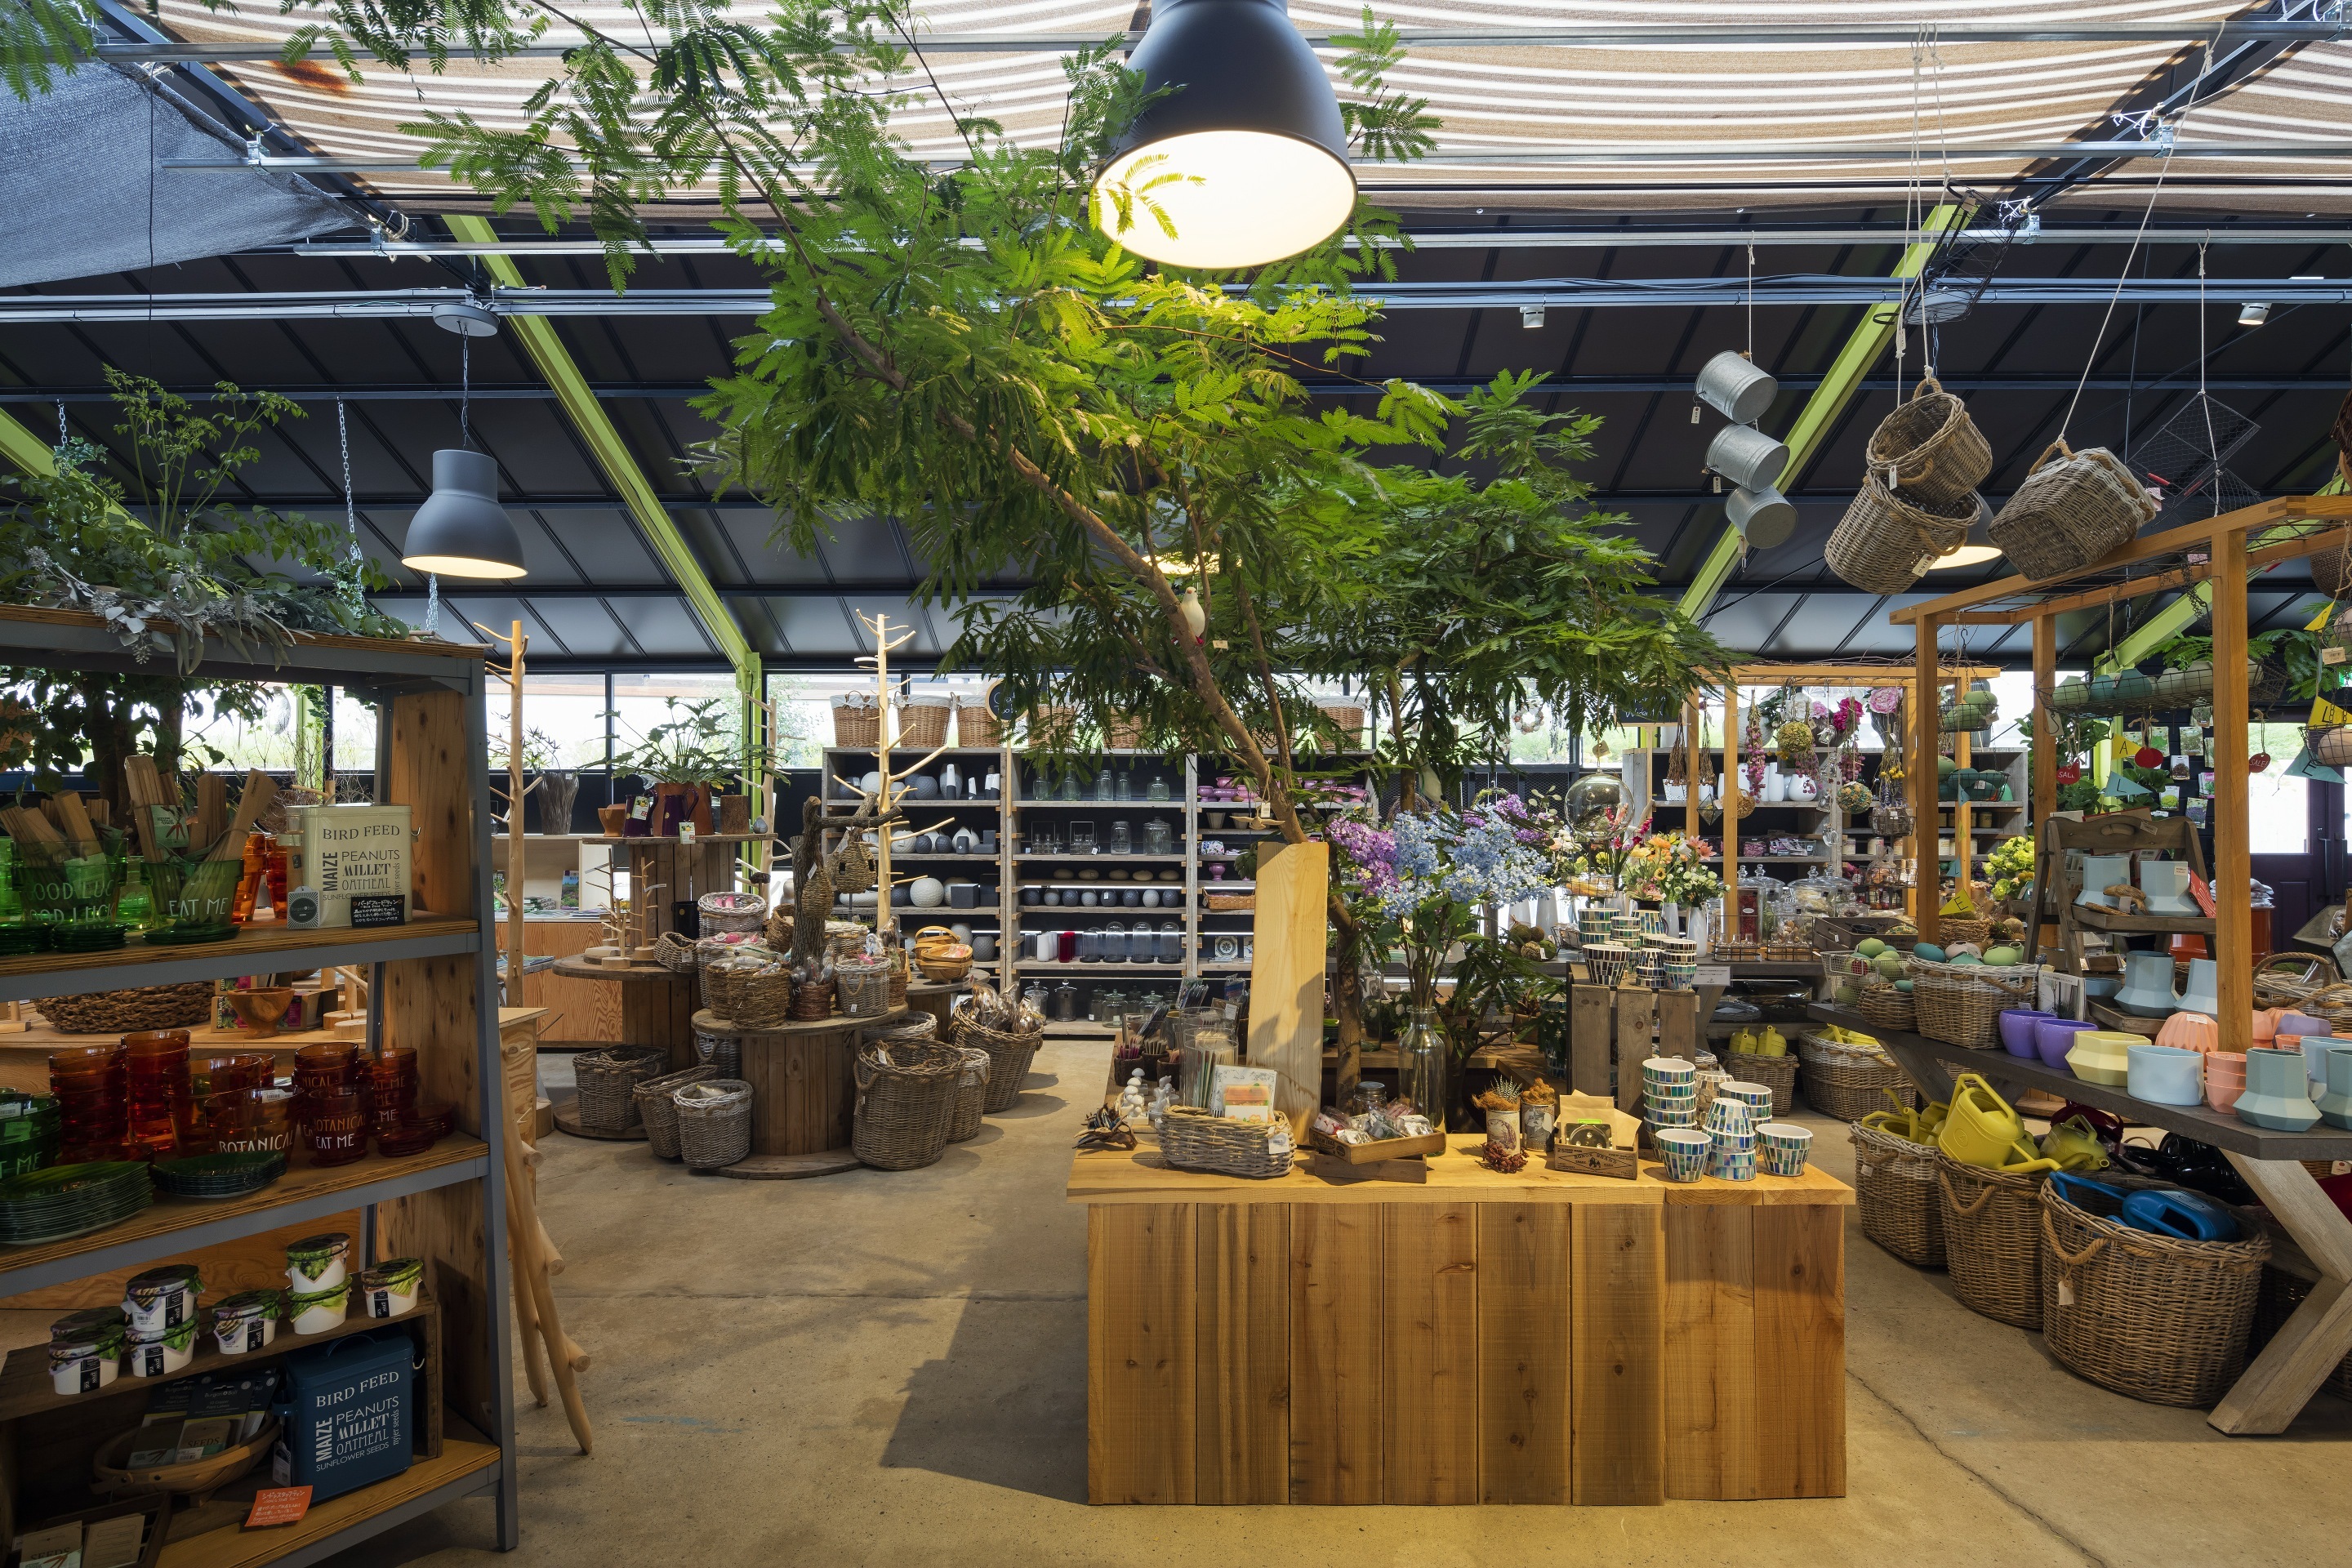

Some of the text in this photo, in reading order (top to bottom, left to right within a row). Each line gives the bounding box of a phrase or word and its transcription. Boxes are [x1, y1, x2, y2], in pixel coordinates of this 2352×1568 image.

[2119, 740, 2128, 755] A
[323, 825, 400, 840] BIRD FEED
[341, 849, 400, 862] PEANUTS
[323, 852, 338, 892] MAIZE
[342, 863, 391, 877] MILLET
[341, 878, 391, 891] OATMEAL
[168, 898, 228, 916] EAT ME
[323, 892, 369, 901] SUNFLOWER
[1953, 896, 1969, 911] E
[219, 1129, 293, 1153] BOTANICAL
[316, 1133, 355, 1150] EAT ME
[16, 1151, 43, 1175] ME
[316, 1371, 399, 1408] BIRD FEED
[336, 1396, 399, 1425] PEANUTS
[336, 1412, 390, 1441] MILLET
[391, 1409, 401, 1446] nyjer seeds
[187, 1437, 220, 1448] SEEDS
[315, 1416, 332, 1463] MAIZE
[336, 1428, 390, 1455] OATMEAL
[316, 1441, 390, 1472] SUNFLOWER SEEDS
